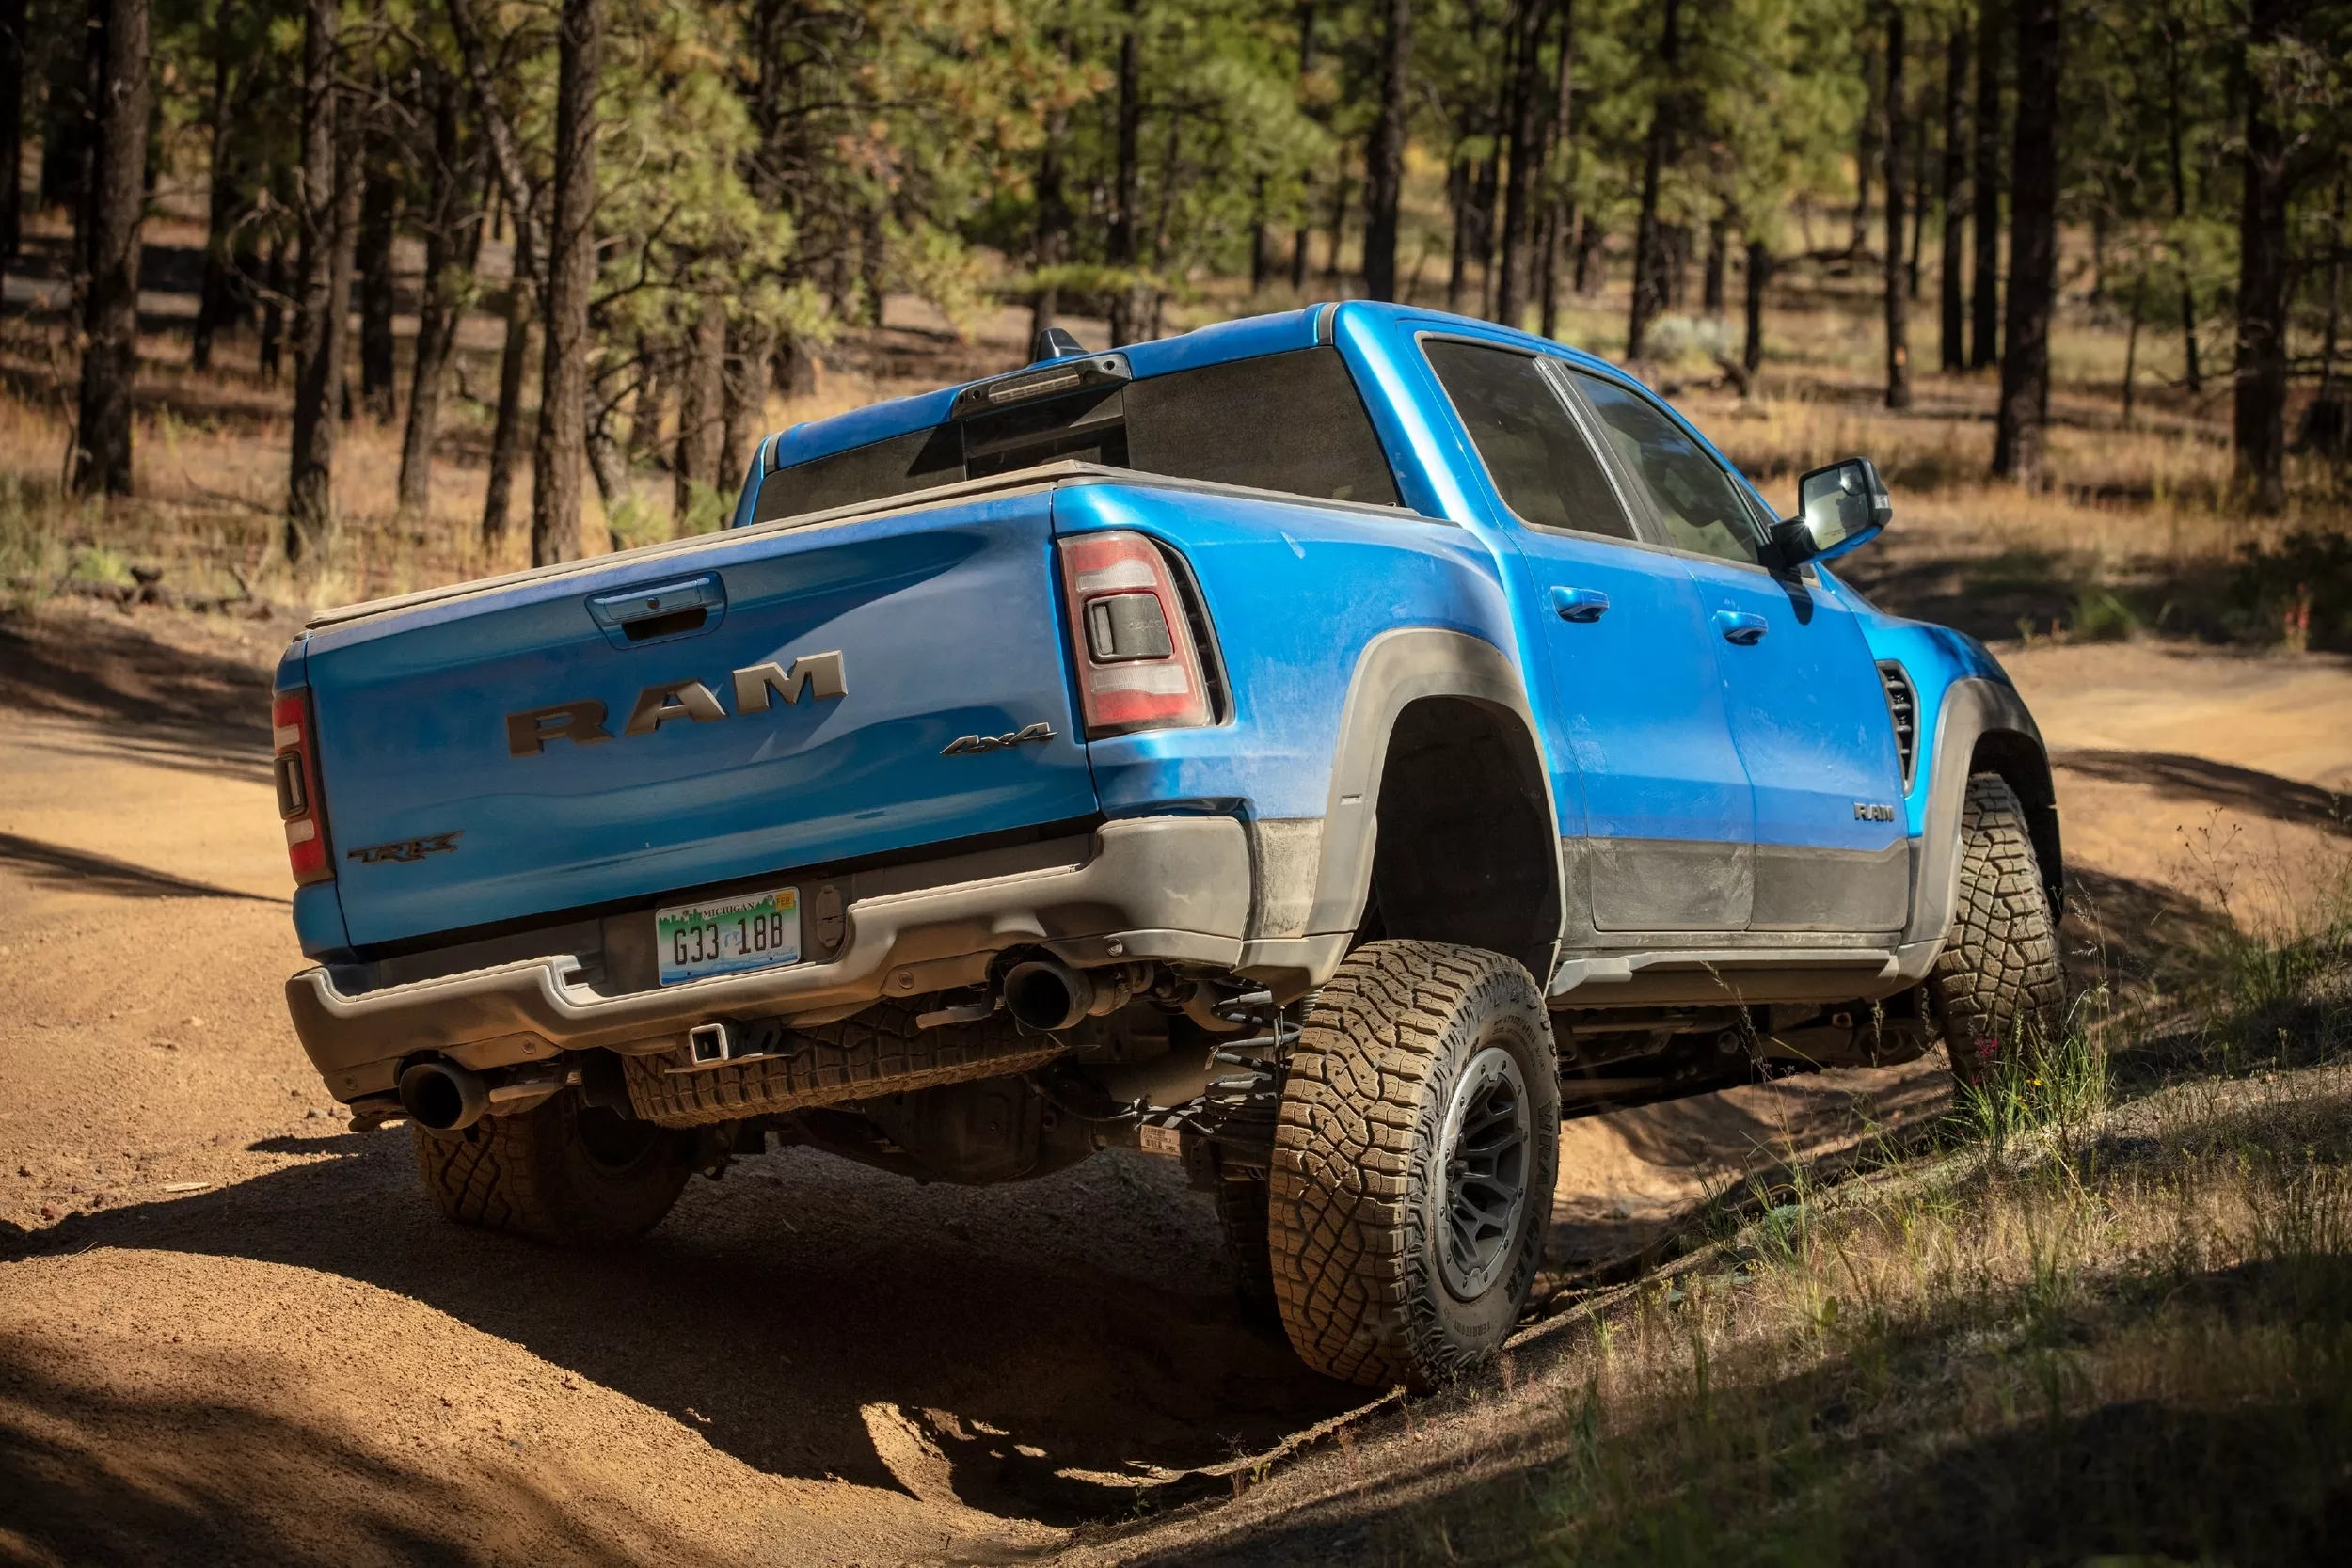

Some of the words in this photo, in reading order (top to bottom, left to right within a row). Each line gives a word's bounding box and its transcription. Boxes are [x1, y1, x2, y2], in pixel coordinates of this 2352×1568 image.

[506, 649, 849, 758] RAM
[1853, 802, 1894, 822] RAM
[703, 902, 755, 918] MICHIGAN
[674, 923, 720, 965] G33
